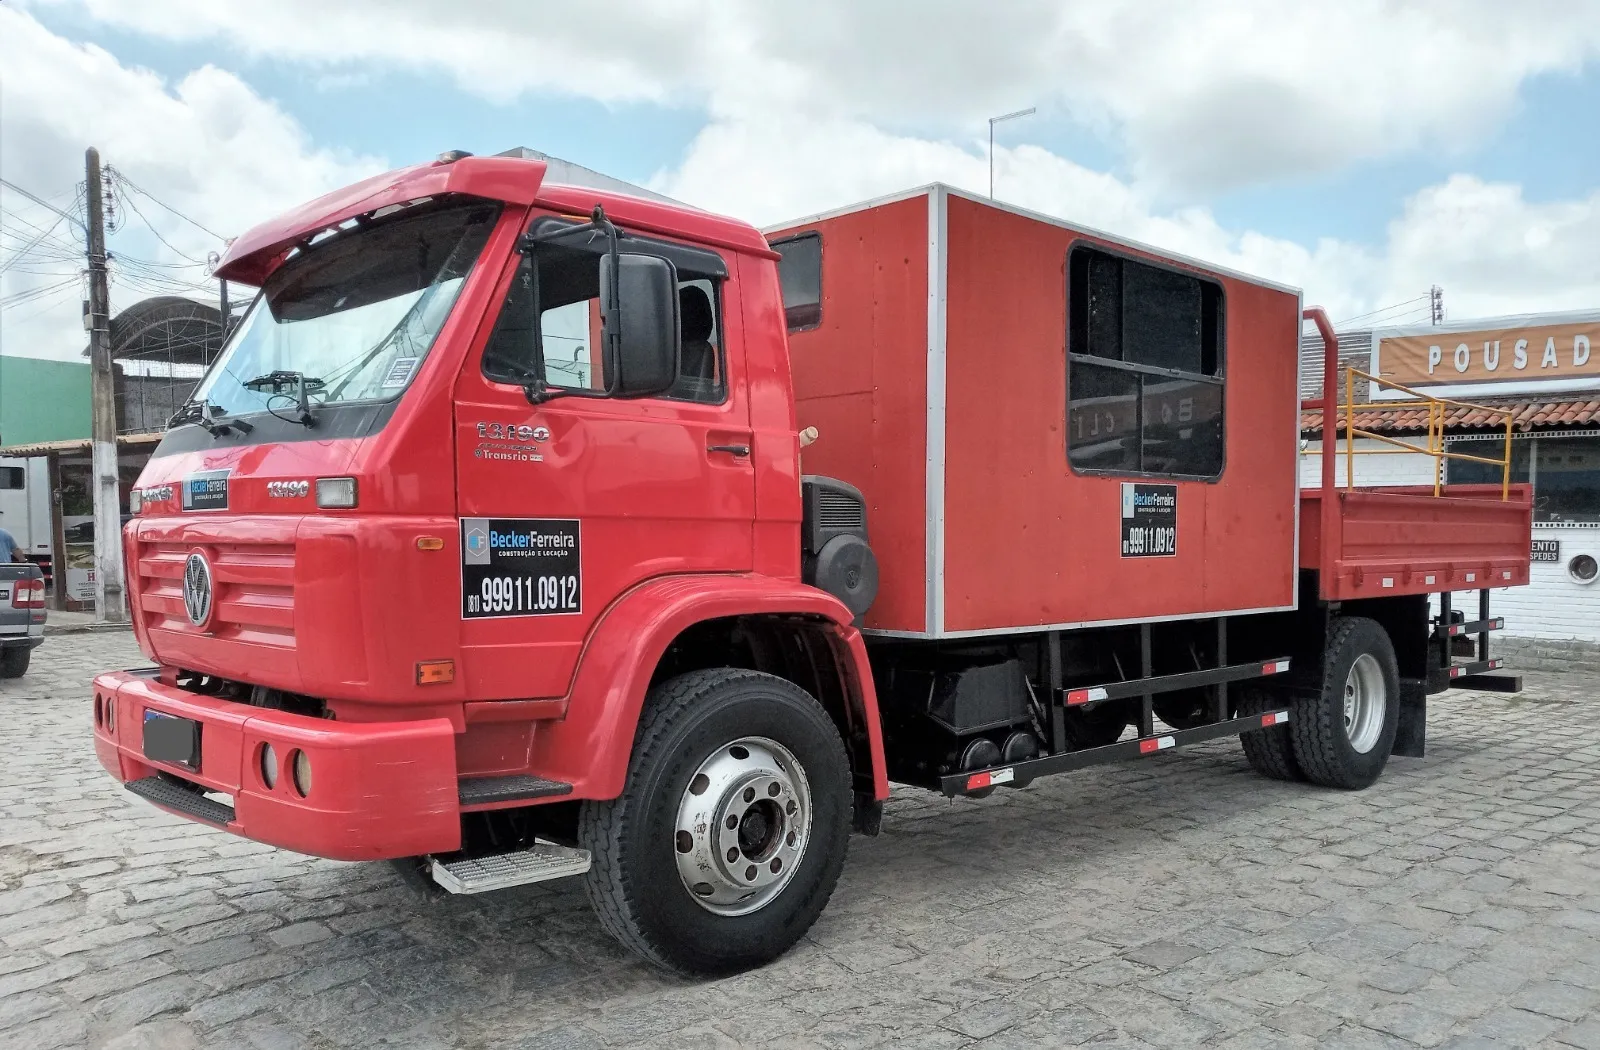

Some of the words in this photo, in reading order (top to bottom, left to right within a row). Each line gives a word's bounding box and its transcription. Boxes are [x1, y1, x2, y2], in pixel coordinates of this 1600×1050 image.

[1428, 334, 1591, 375] POUSAD
[476, 422, 550, 443] 13.190
[483, 449, 528, 461] Transrio
[1134, 493, 1175, 506] BeckerFerreira
[490, 530, 575, 548] BeckerFerreira
[1129, 527, 1175, 553] 99911.0912
[1531, 541, 1556, 551] ENTO
[498, 550, 536, 558] CONSTRUÇÃO
[543, 549, 568, 557] LOCAÇÃO
[481, 575, 577, 612] 99911.0912
